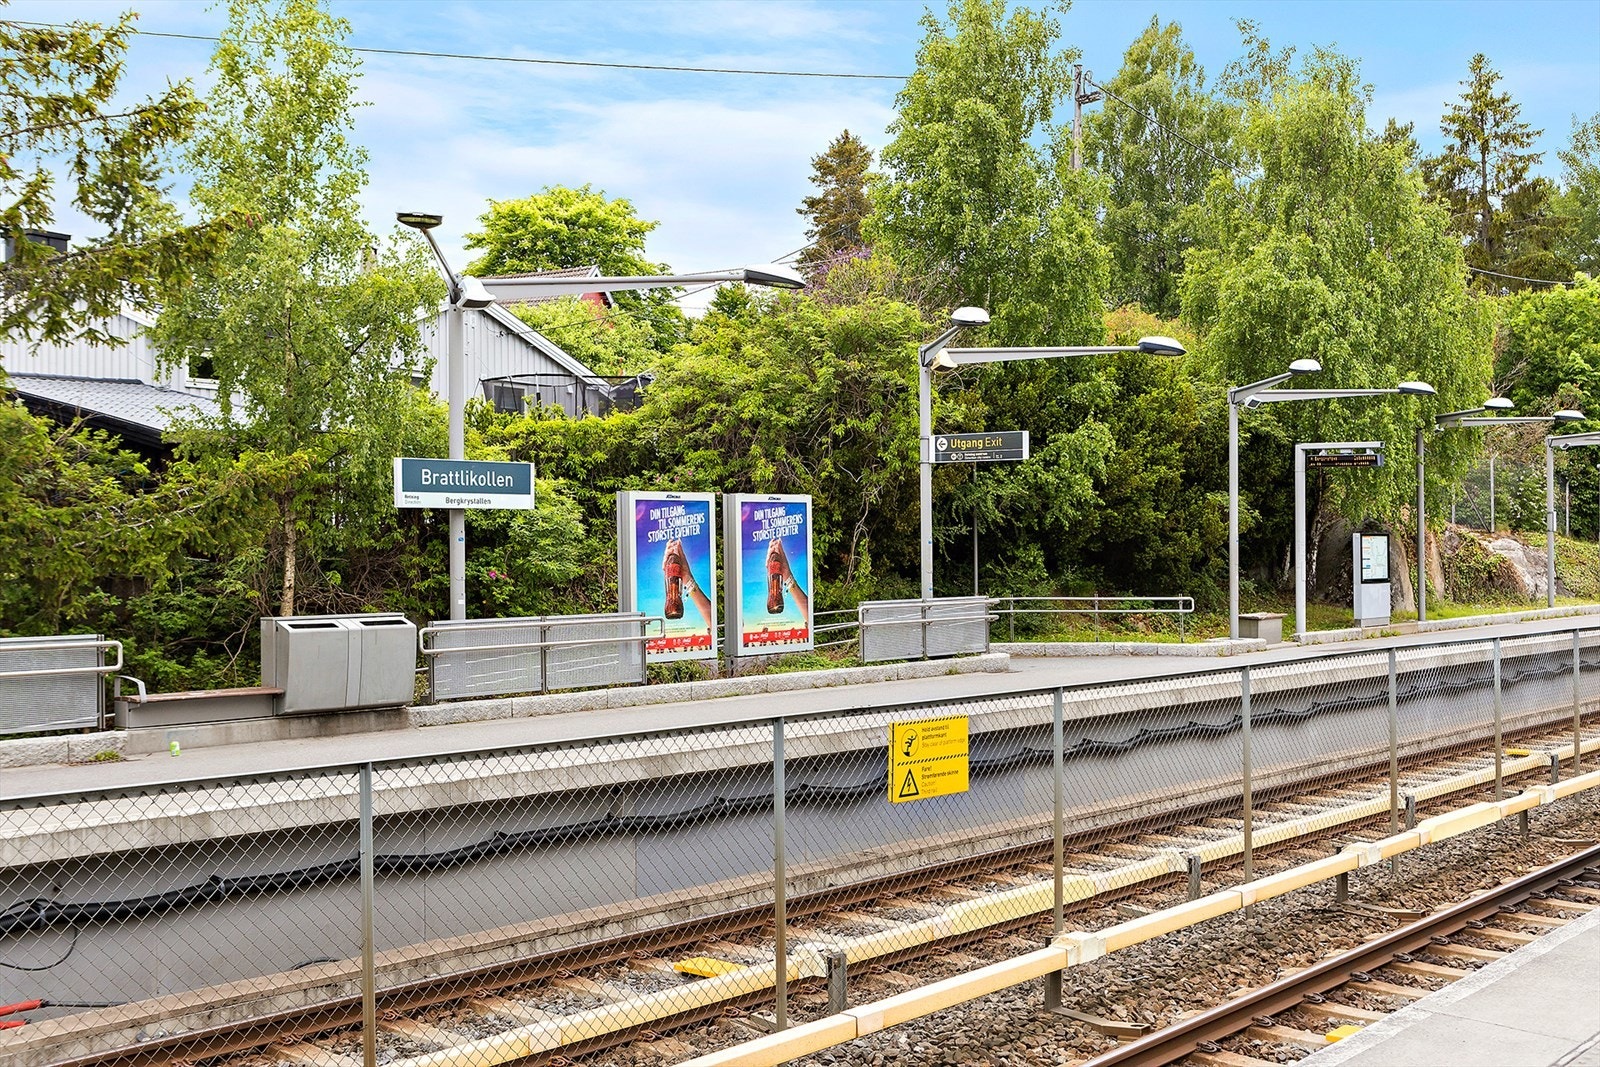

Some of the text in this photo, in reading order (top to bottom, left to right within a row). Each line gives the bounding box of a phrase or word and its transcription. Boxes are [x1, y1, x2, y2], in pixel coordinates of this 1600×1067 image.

[950, 436, 1002, 450] Utgang Exit
[421, 468, 514, 488] Brattlikollen
[445, 496, 492, 506] Bergkrystallen
[650, 504, 686, 520] DIN TILGANG
[754, 506, 786, 521] DIN TILGANG
[658, 512, 705, 530] TIL SOMMERENS
[762, 514, 803, 530] TIL SOMMERENS
[648, 524, 700, 542] STØRSTE EVENTER
[753, 525, 798, 542] STØRSTE EVENTER
[922, 733, 947, 741] plattformkant
